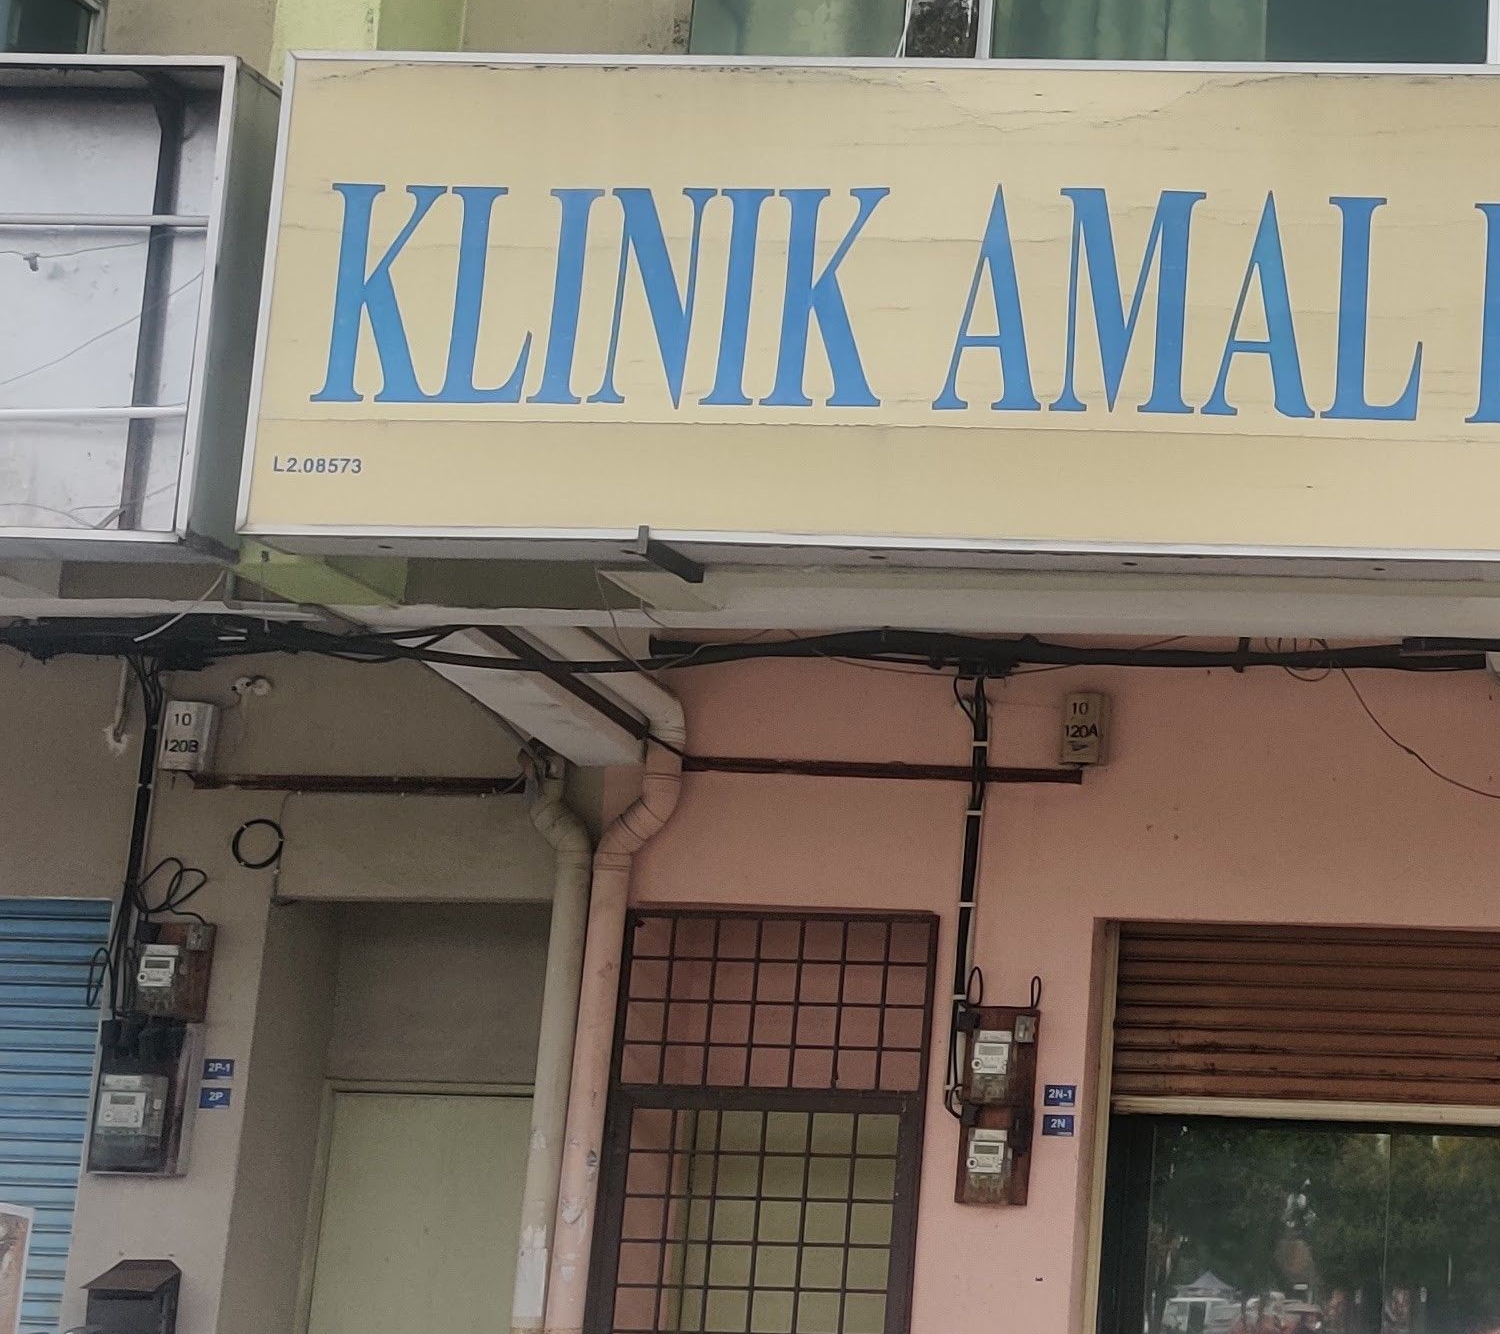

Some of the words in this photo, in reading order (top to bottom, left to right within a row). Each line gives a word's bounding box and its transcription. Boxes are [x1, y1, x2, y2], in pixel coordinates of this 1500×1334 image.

[310, 182, 890, 411] KLINIK
[931, 183, 1424, 421] AMAL
[273, 455, 362, 474] L2.08573
[174, 713, 192, 726] 10
[1064, 723, 1098, 738] 120A
[208, 1062, 231, 1072] 2P-1
[208, 1091, 224, 1102] 2P
[1048, 1088, 1073, 1099] 2N-1
[1050, 1118, 1066, 1128] 2N
